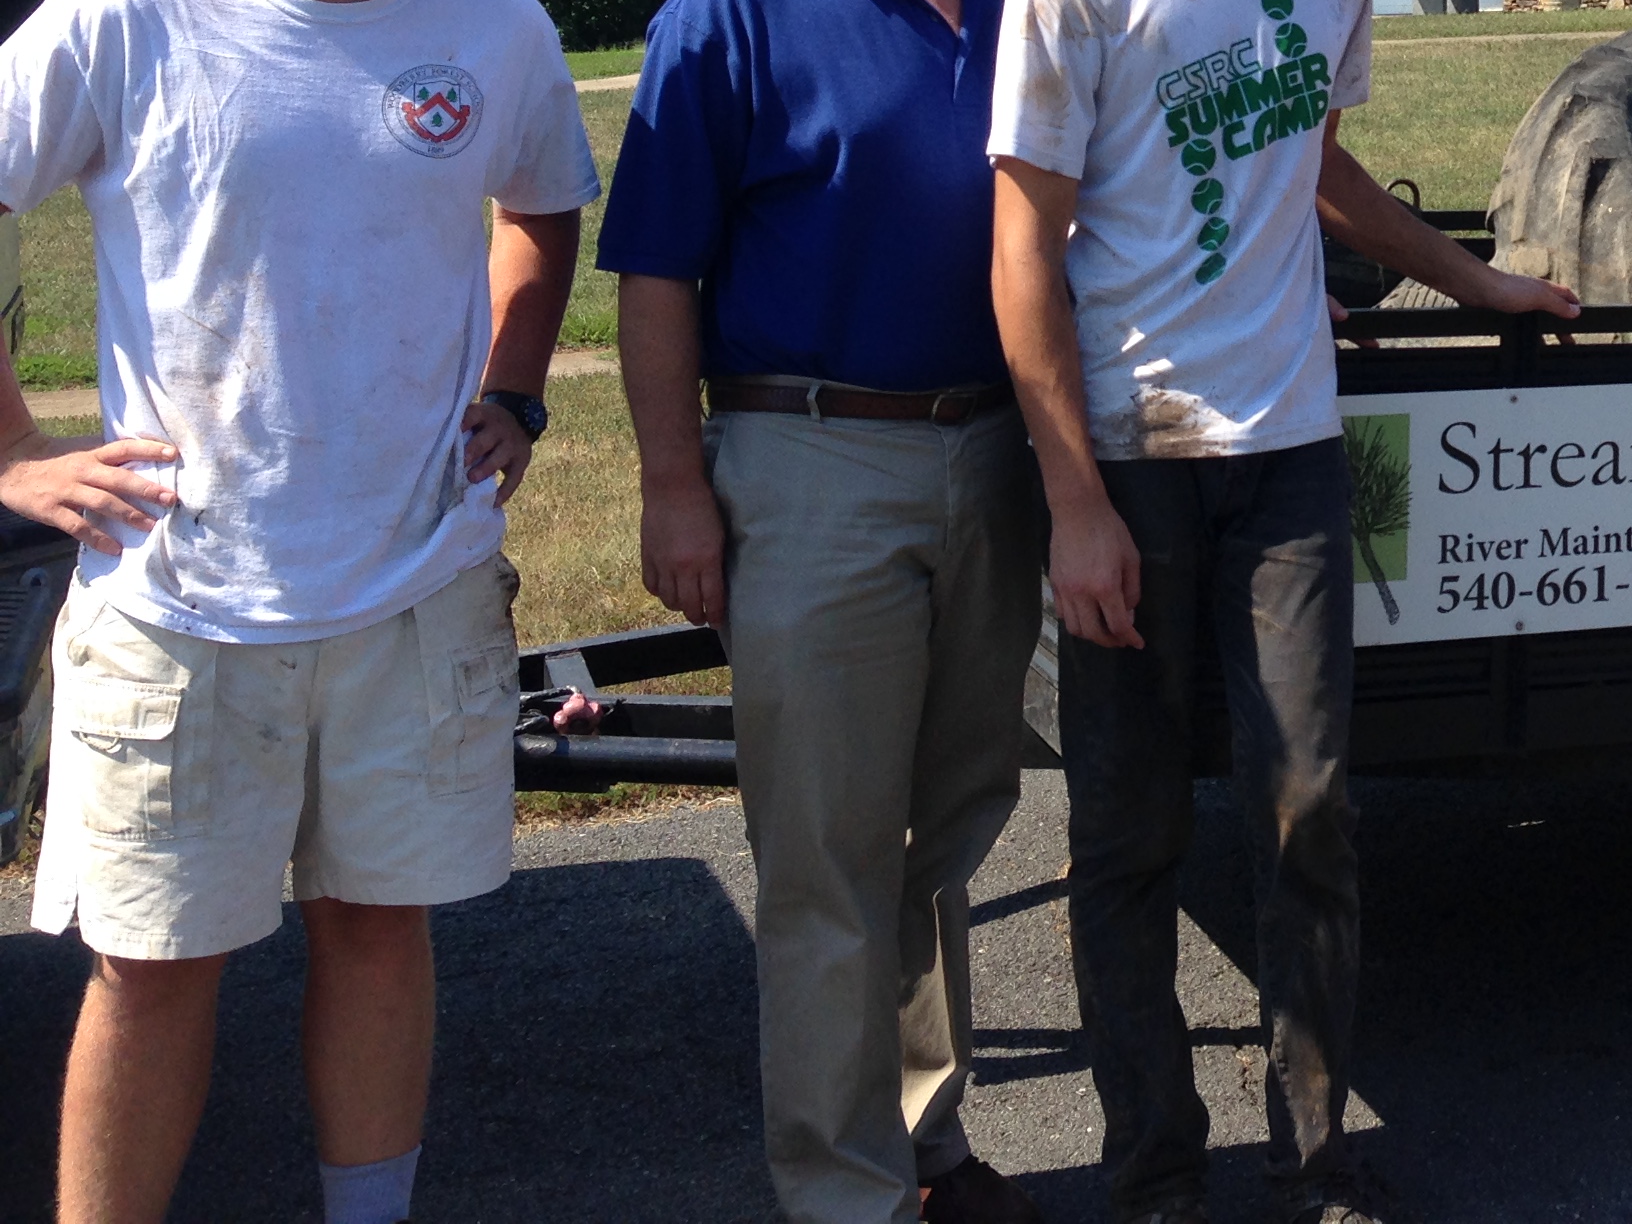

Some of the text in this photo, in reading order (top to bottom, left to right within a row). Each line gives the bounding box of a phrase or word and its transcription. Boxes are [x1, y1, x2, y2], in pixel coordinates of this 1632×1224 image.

[1156, 38, 1262, 111] CSRC
[1165, 52, 1333, 148] SUMMER
[1222, 89, 1329, 161] CAMP
[1438, 532, 1528, 566] River
